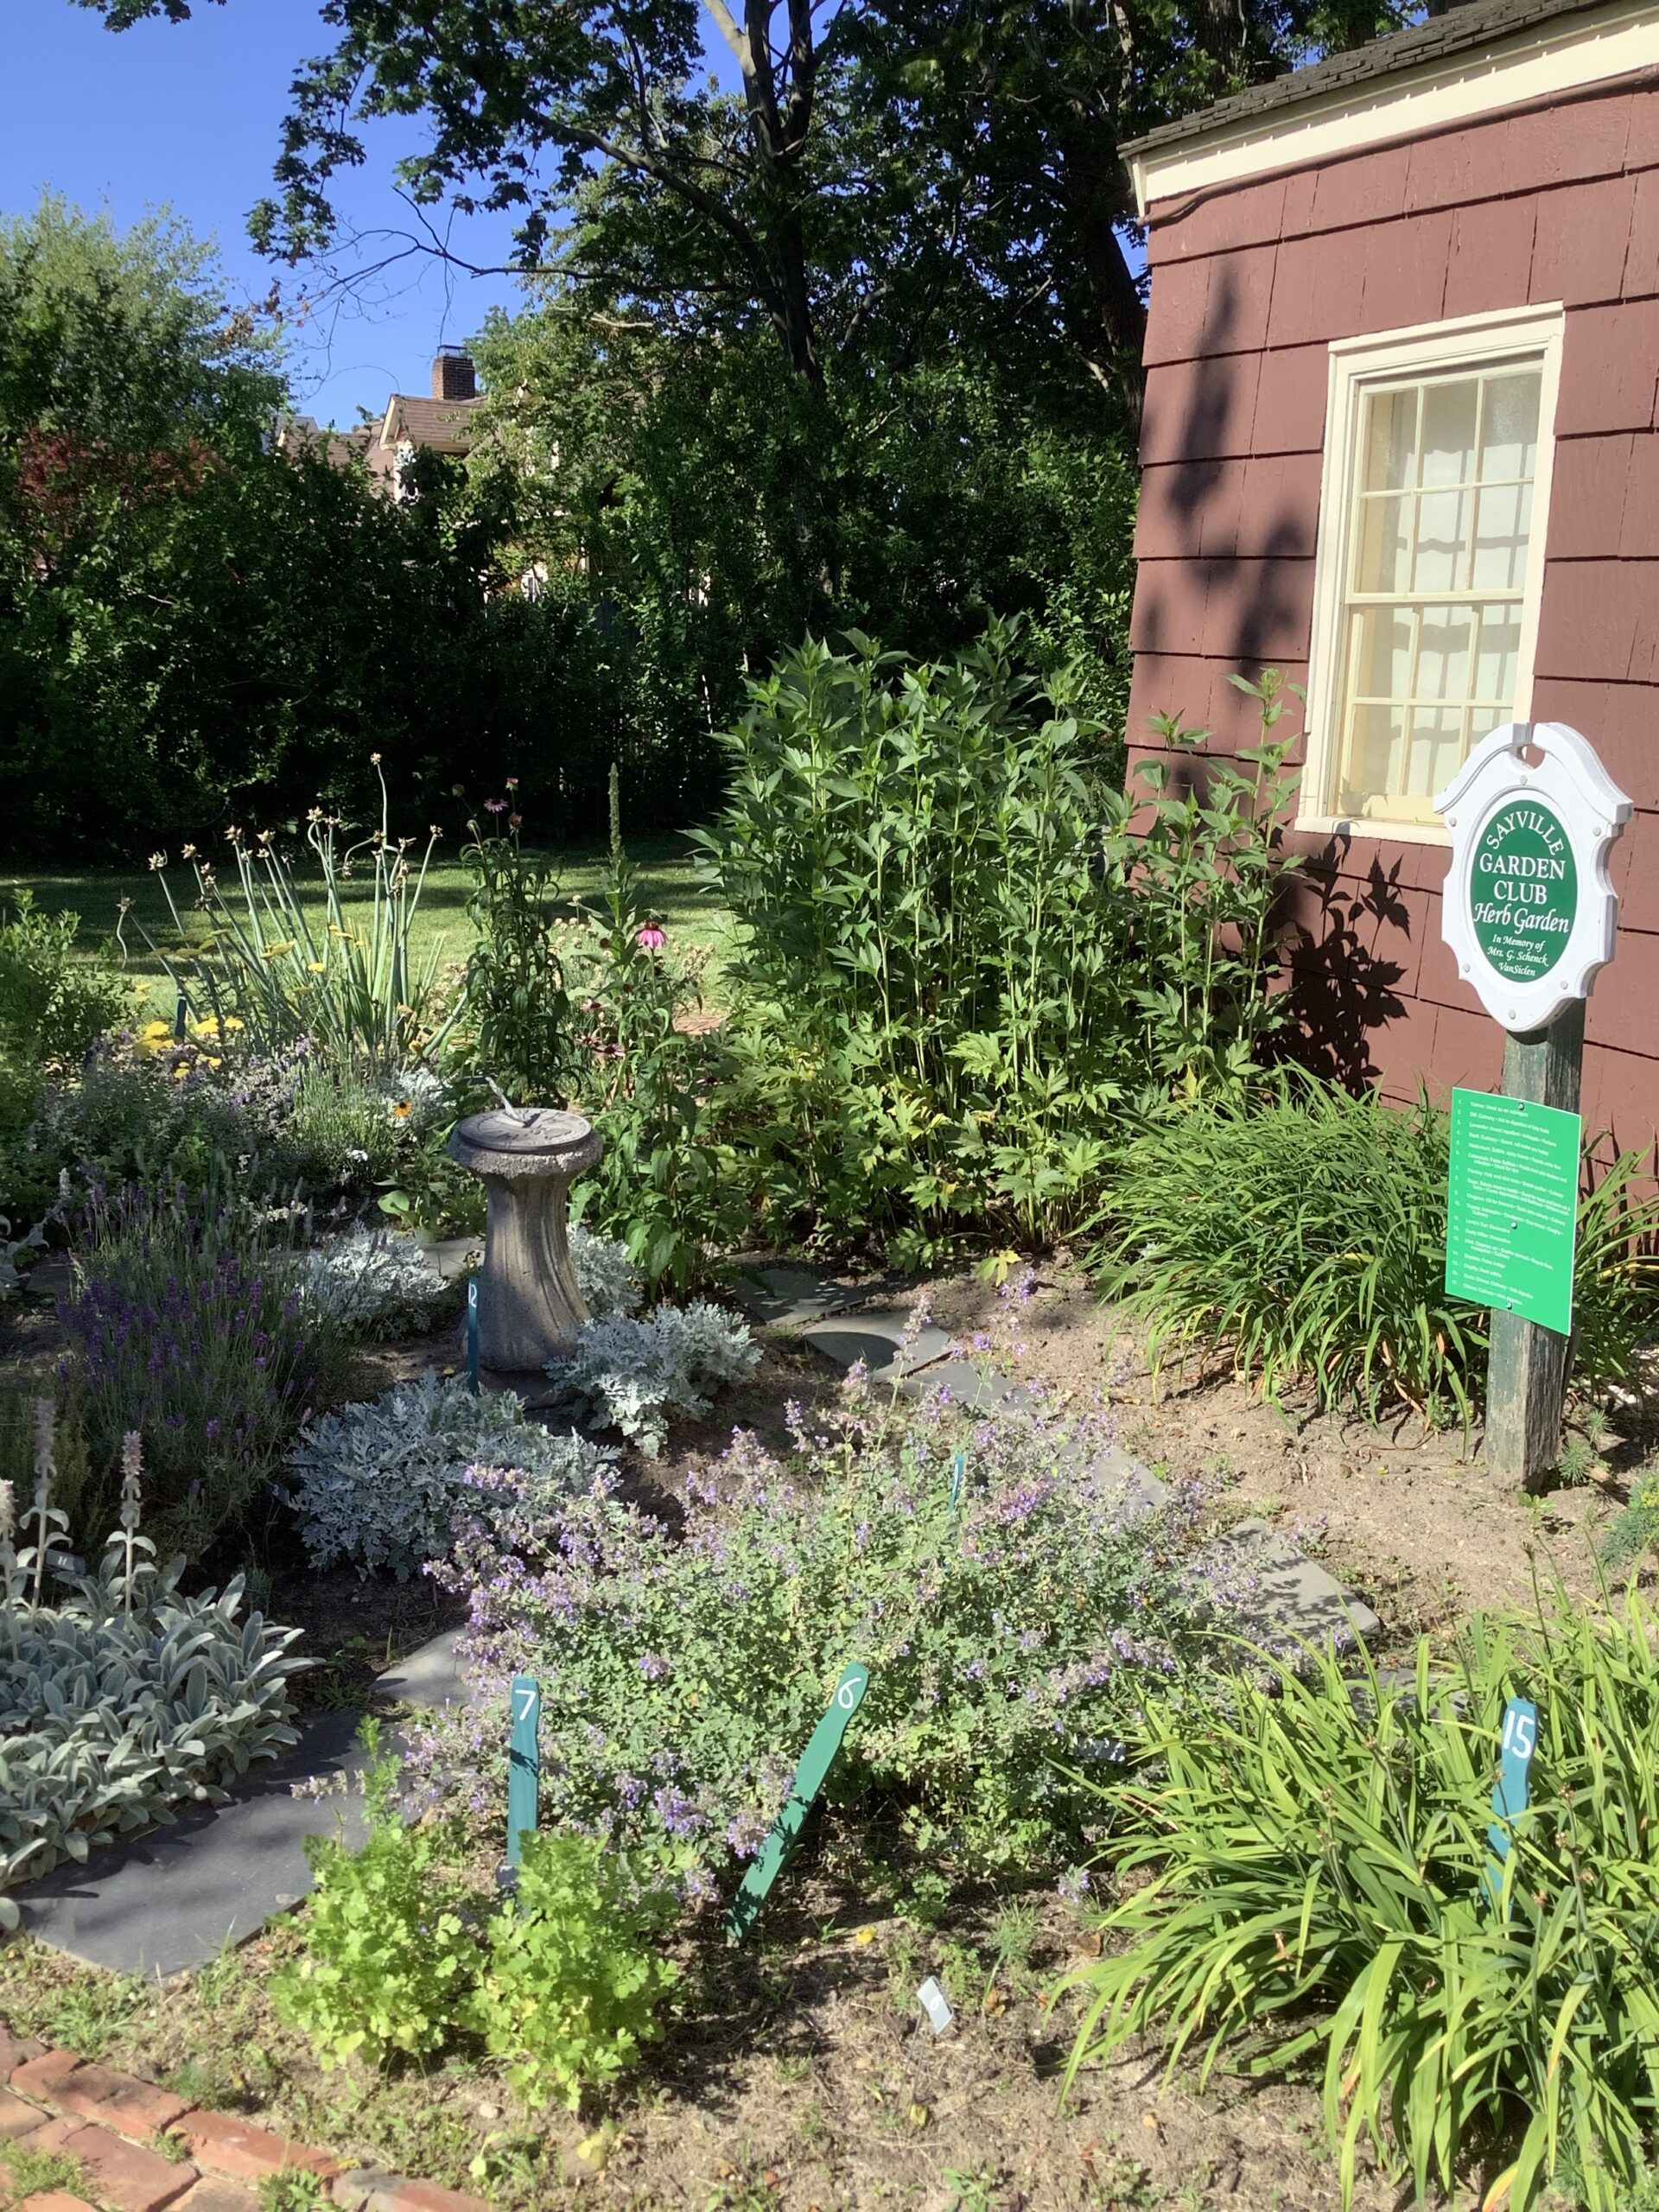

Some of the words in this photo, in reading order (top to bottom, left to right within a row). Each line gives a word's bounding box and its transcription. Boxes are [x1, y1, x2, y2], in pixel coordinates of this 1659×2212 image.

[1486, 810, 1564, 855] SAYVILLE
[1479, 853, 1566, 880] GARDEN
[1494, 880, 1547, 904] CLUB
[1473, 902, 1512, 925] Herb
[1514, 907, 1569, 934] Garden
[1487, 946, 1504, 957] Mrs.
[1516, 951, 1549, 967] Schenck
[1492, 934, 1502, 944] In
[1503, 936, 1535, 951] Memory
[1535, 940, 1547, 953] of
[515, 1689, 537, 1720] 7
[837, 1677, 862, 1709] 6
[1503, 1710, 1535, 1758] 15
